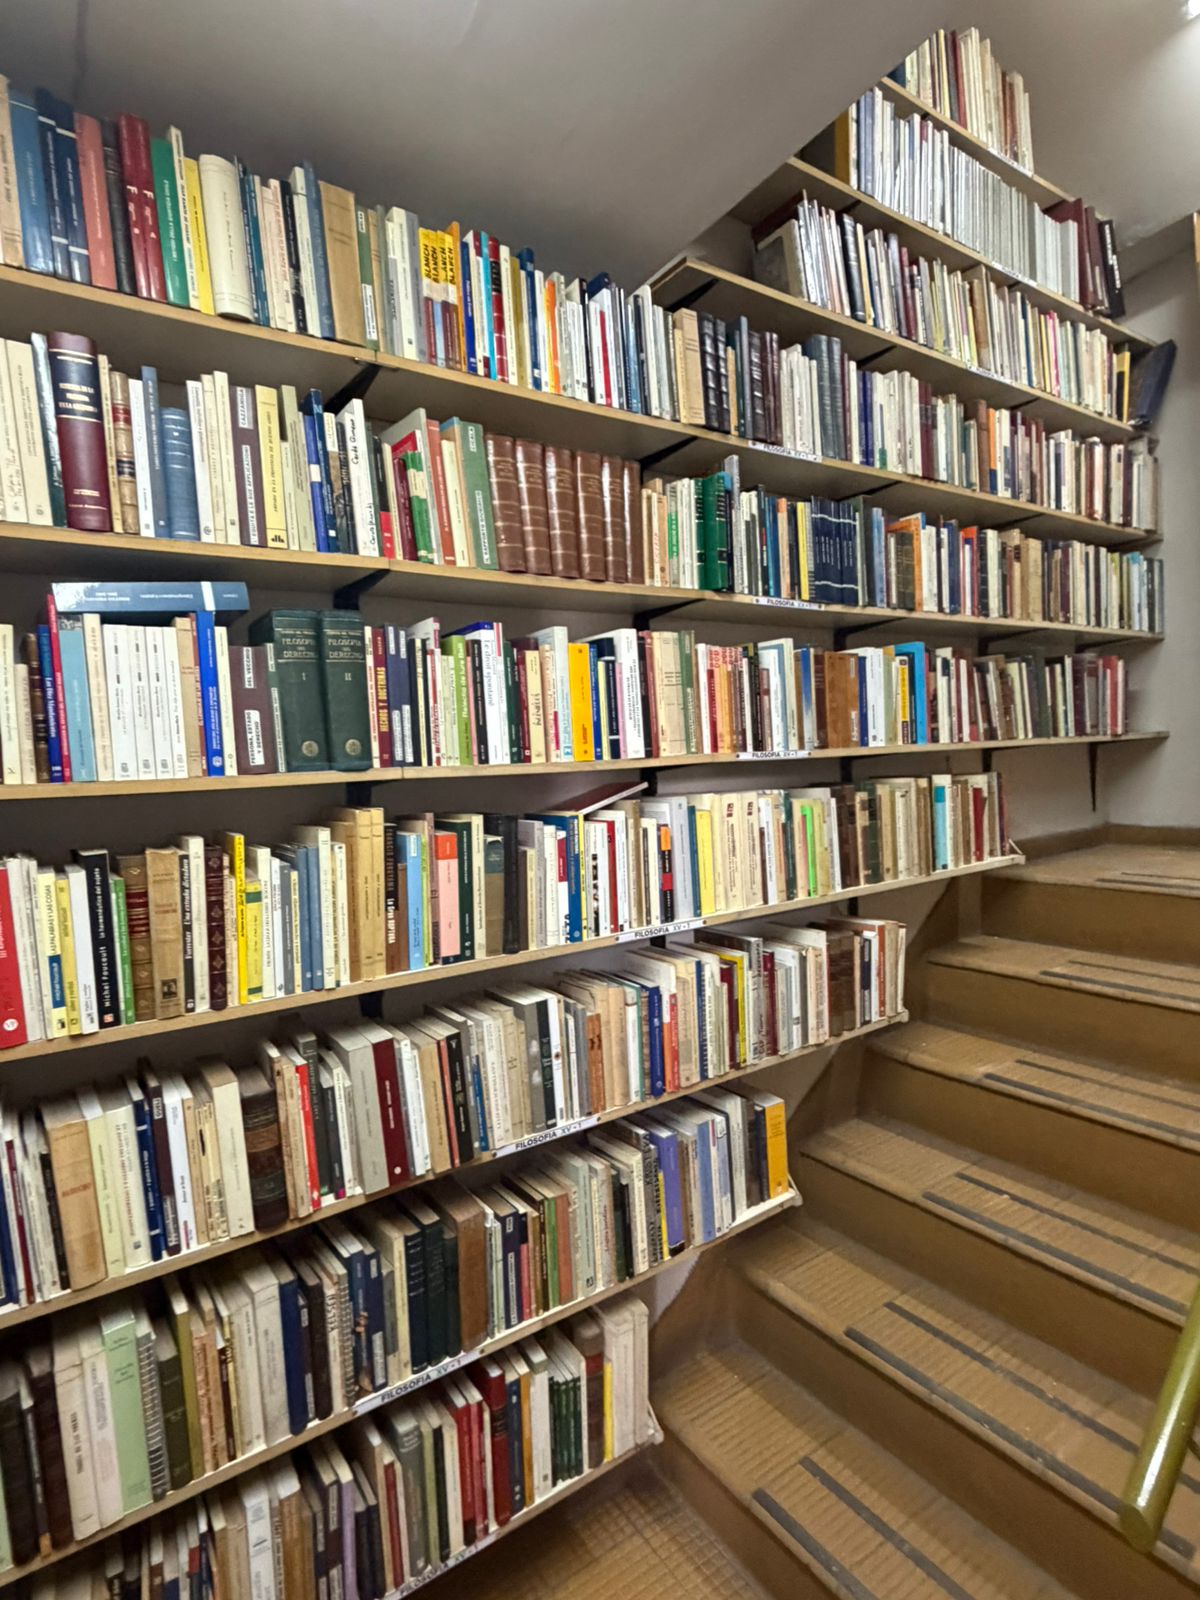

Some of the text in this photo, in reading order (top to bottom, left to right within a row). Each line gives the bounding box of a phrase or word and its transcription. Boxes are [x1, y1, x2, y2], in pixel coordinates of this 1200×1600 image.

[423, 244, 432, 278] BLANCH
[378, 667, 387, 700] DOCTRINAS
[460, 676, 466, 686] de
[486, 672, 494, 706] spontané
[381, 709, 389, 732] HECHOS
[97, 895, 105, 931] hermenéutica
[635, 927, 669, 937] FILOSOFIA
[100, 946, 109, 980] Foucault
[515, 1131, 557, 1150] FILOSOFIA
[381, 1374, 432, 1402] FILOSOFIA
